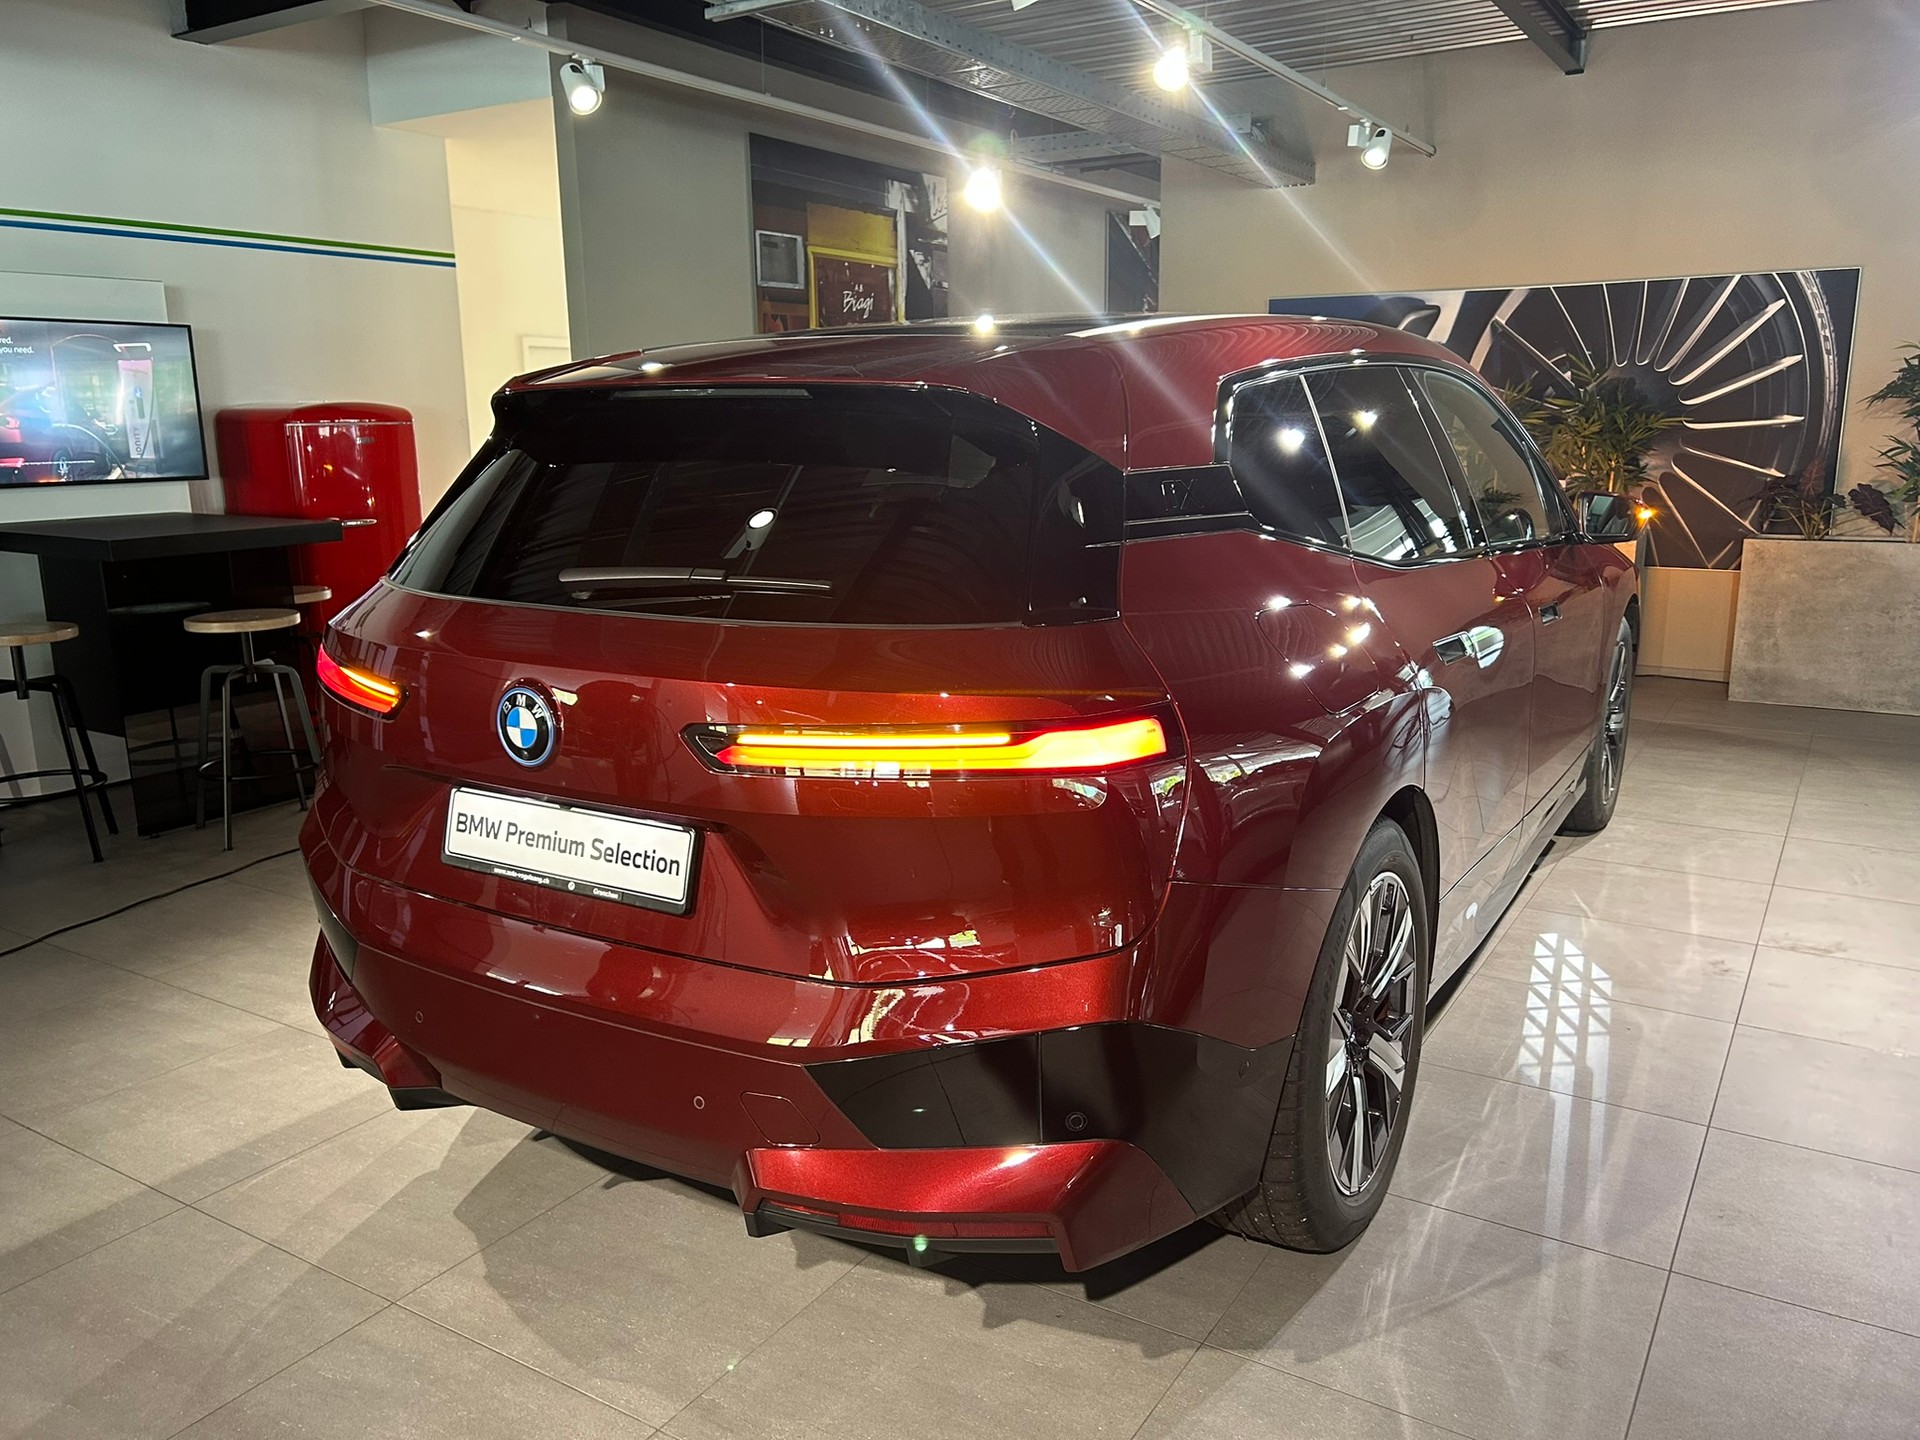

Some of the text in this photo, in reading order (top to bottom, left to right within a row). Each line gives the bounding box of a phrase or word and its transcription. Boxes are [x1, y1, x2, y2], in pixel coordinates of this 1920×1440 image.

[842, 291, 873, 318] Biagi
[13, 345, 35, 354] need.
[503, 694, 544, 718] BMW
[456, 812, 681, 876] BMW Premium Selection
